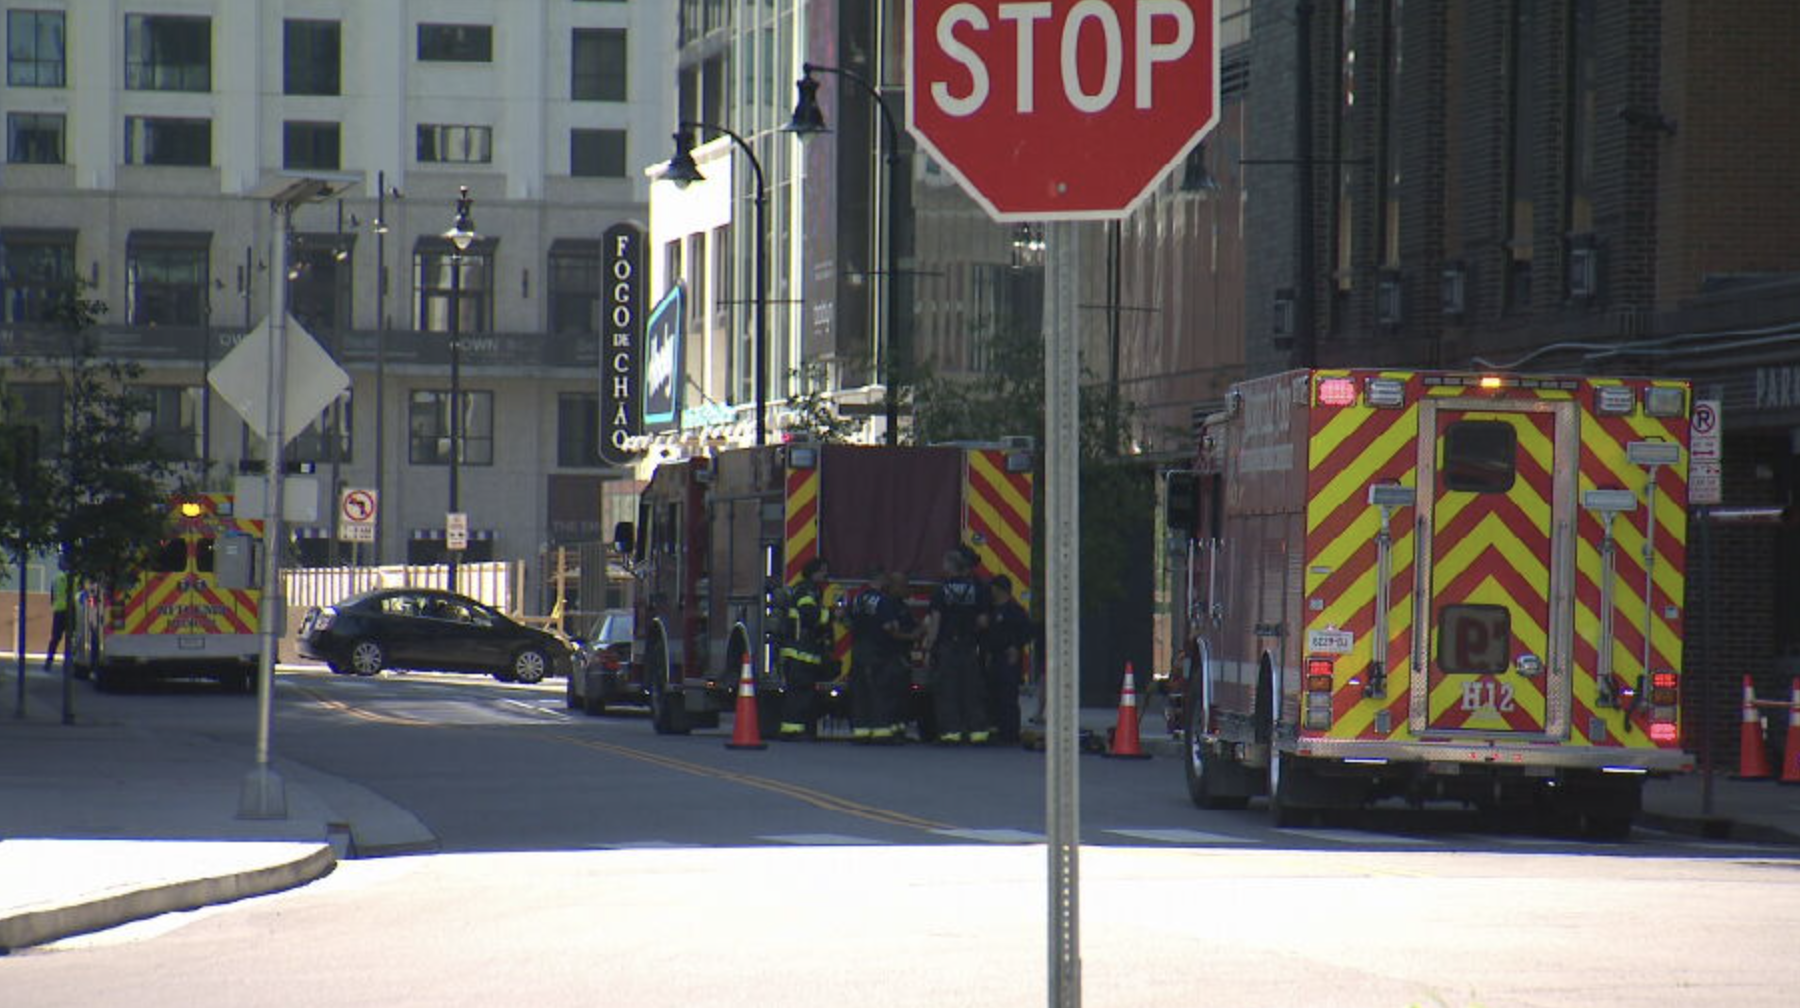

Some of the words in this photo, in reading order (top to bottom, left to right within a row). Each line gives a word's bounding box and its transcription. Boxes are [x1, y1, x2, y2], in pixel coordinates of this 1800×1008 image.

[930, 0, 1196, 118] STOP
[613, 235, 632, 327] FOGO
[612, 333, 631, 347] DE
[1460, 681, 1515, 712] H12
